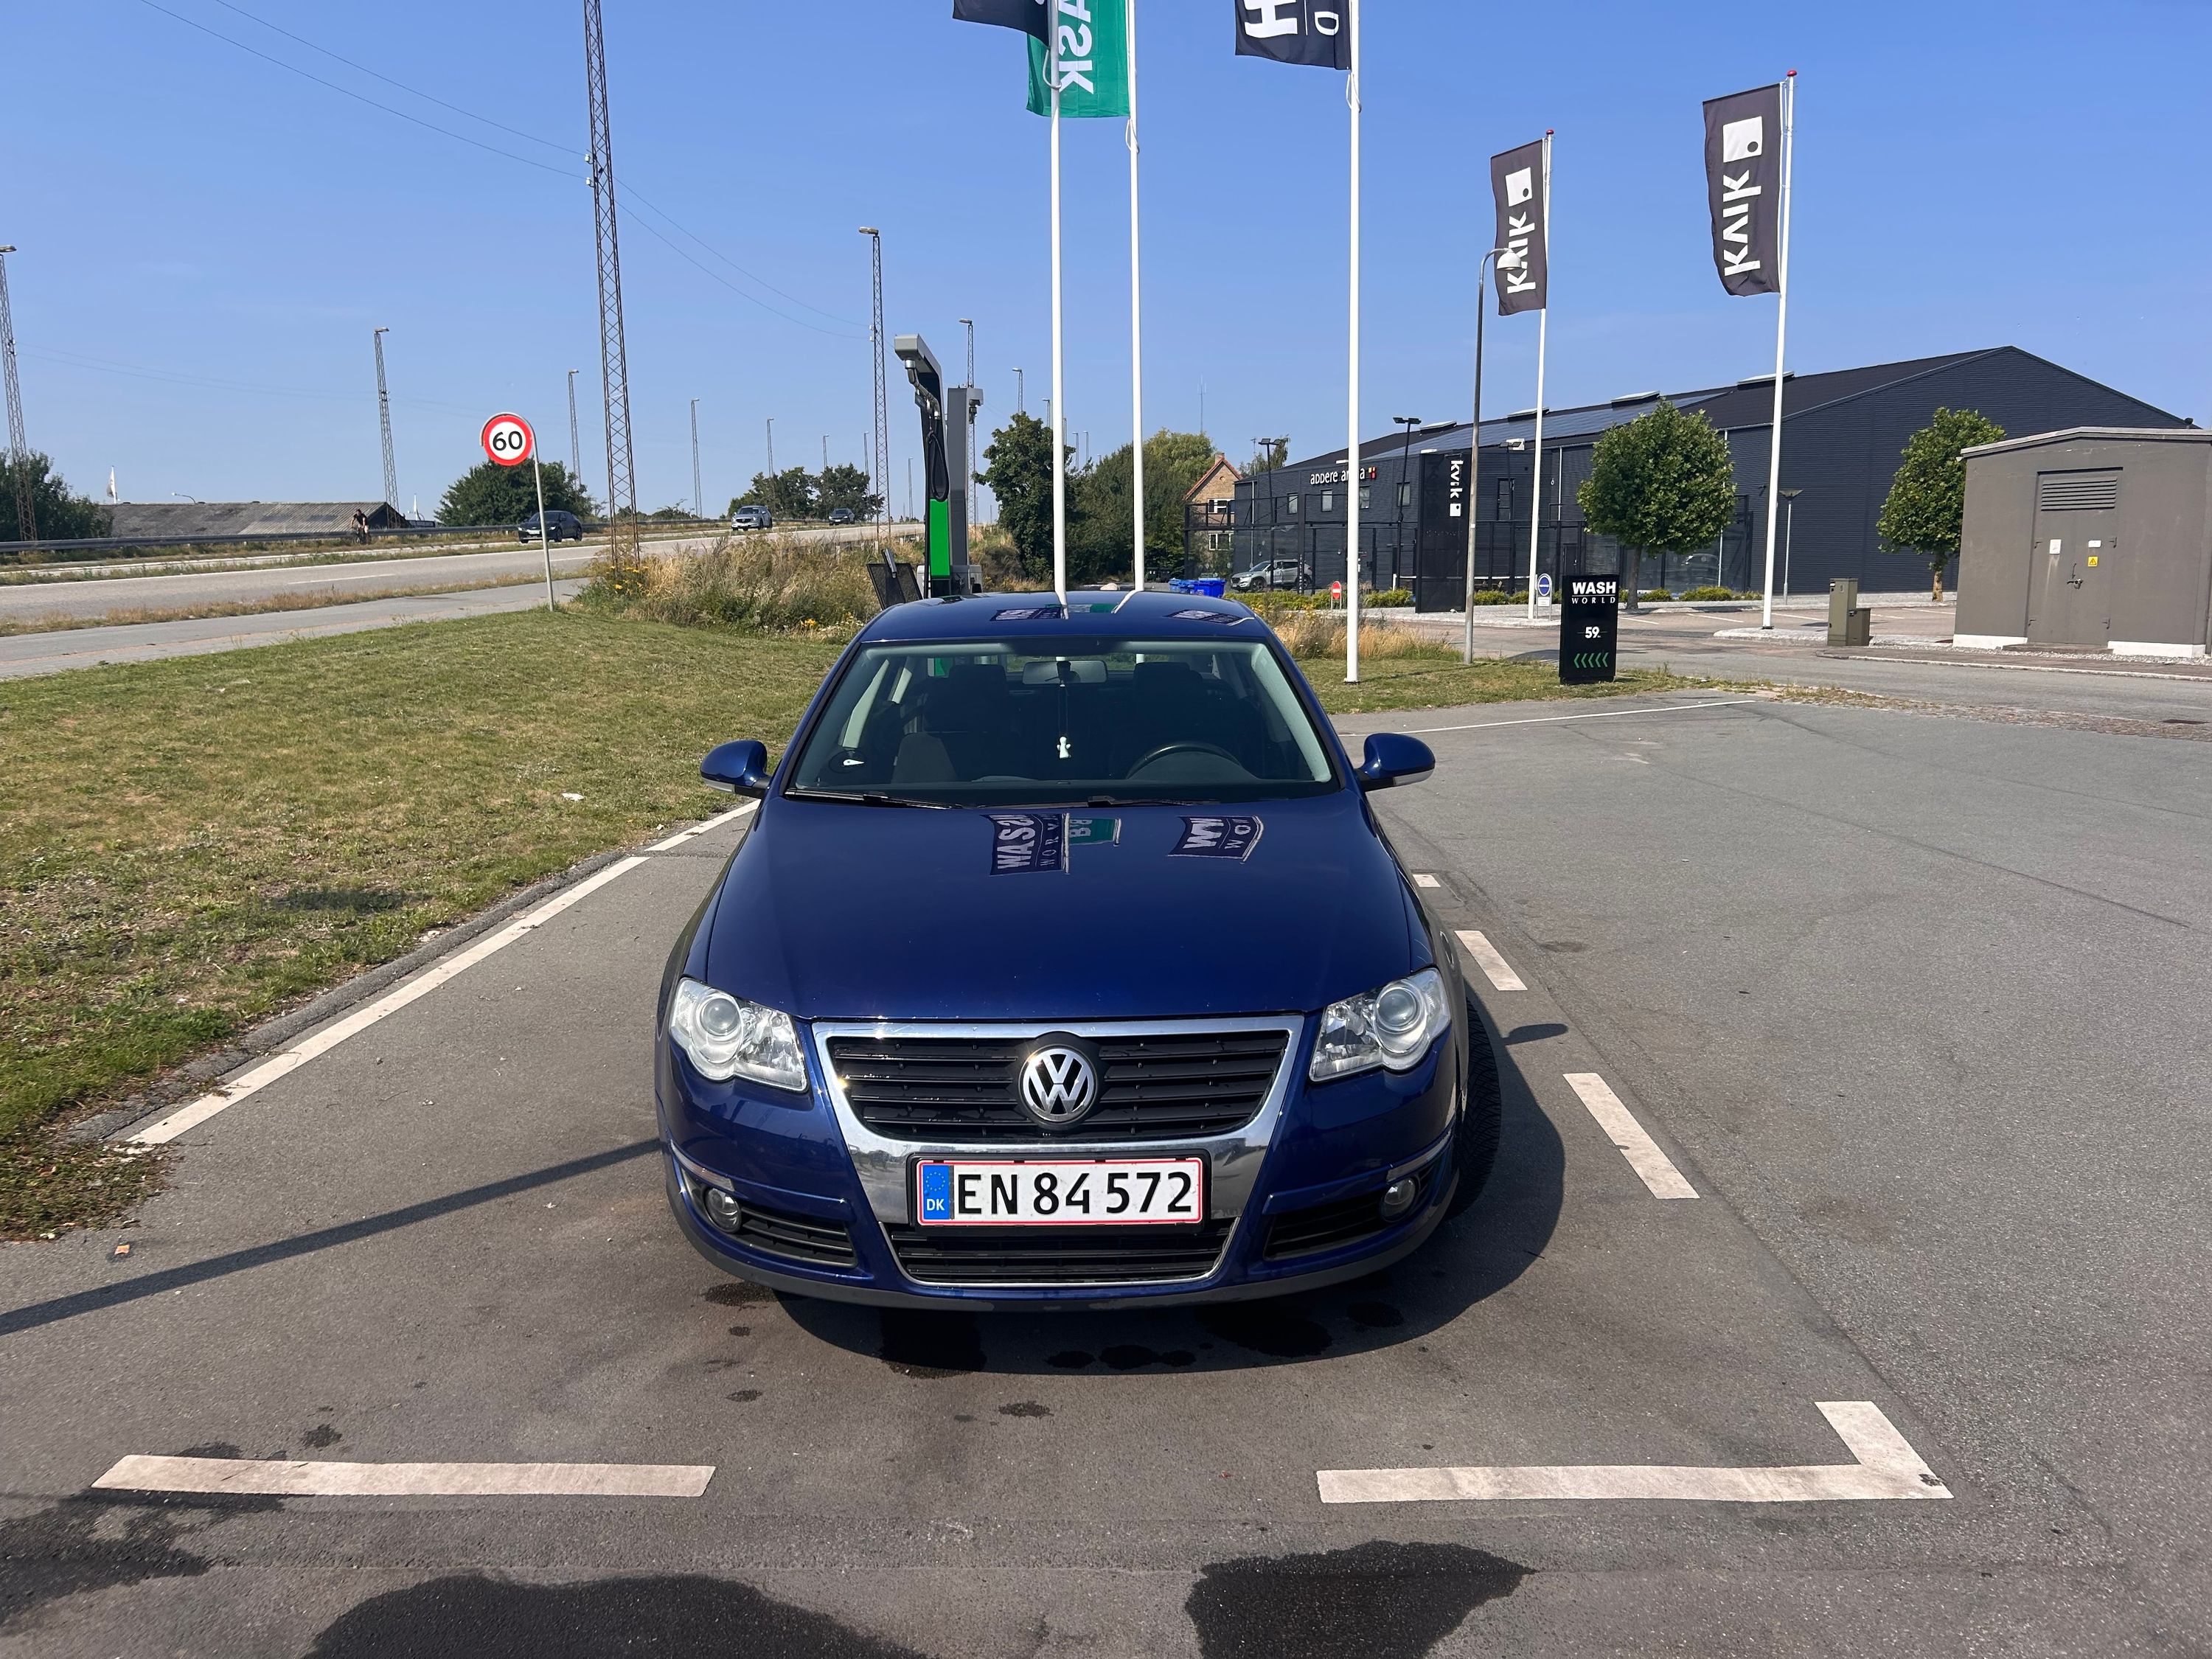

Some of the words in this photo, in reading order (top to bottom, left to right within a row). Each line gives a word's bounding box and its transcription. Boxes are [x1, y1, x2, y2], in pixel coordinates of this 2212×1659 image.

[493, 431, 523, 451] 60
[1450, 460, 1464, 498] kvik
[1572, 582, 1616, 595] WASH
[1571, 597, 1615, 605] WORLD
[1585, 626, 1600, 639] 59
[959, 1174, 1018, 1214] EN
[1033, 1172, 1091, 1215] 84
[1106, 1172, 1192, 1213] 572
[926, 1198, 945, 1211] DK
